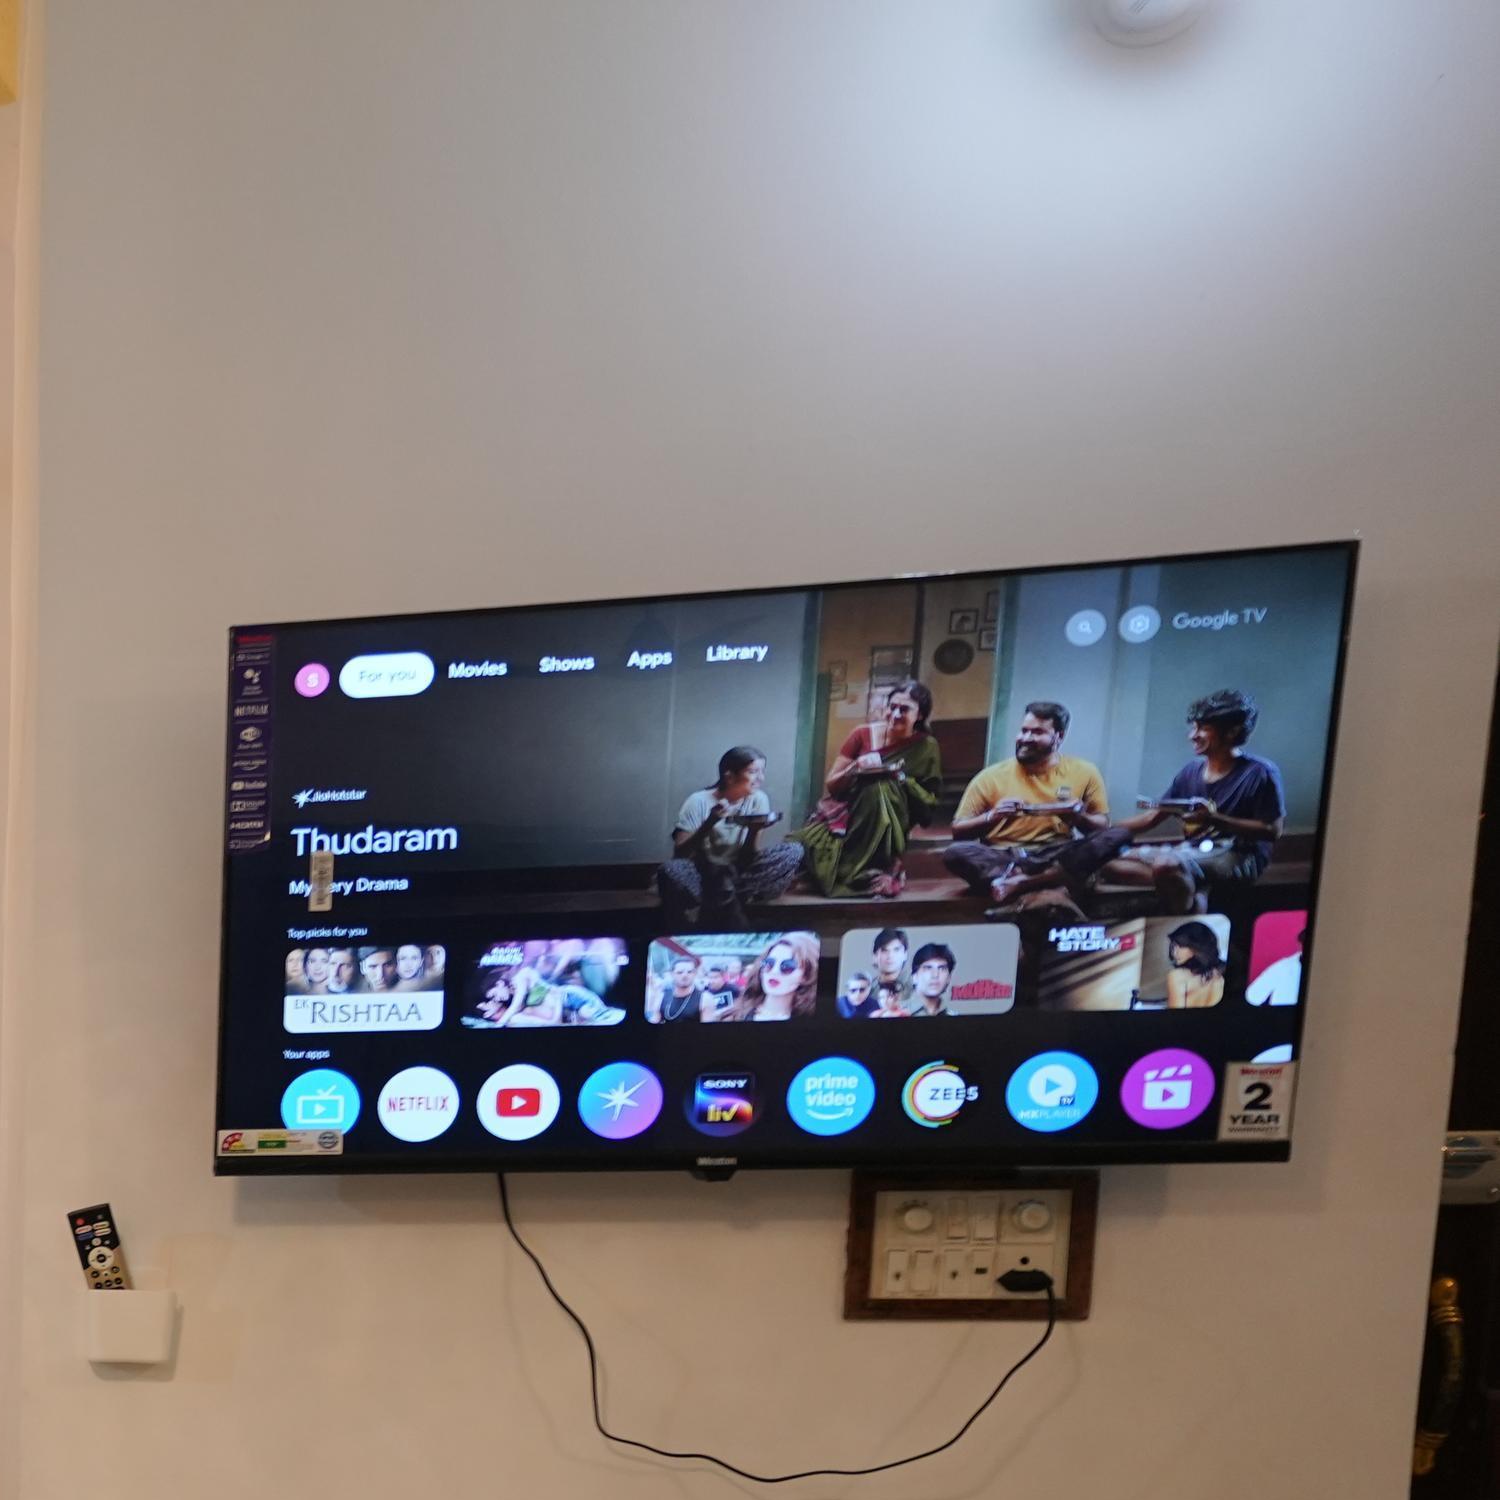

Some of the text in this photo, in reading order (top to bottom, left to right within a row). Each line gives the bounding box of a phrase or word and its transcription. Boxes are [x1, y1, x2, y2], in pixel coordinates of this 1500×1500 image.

[1172, 607, 1268, 630] Google TV
[626, 650, 673, 670] Apps
[706, 644, 769, 662] Library
[448, 661, 508, 679] Movies
[538, 656, 595, 673] Shows
[359, 669, 417, 683] For you
[289, 824, 458, 857] Thudaram
[288, 877, 409, 898] Myery Drama
[286, 927, 306, 941] Top
[332, 926, 348, 937] for
[348, 927, 368, 938] you
[1048, 926, 1105, 942] HATE
[1056, 938, 1120, 952] STORY
[311, 1001, 423, 1024] RISHTAA
[283, 1048, 330, 1061] Your apps
[703, 1079, 748, 1089] SONY
[804, 1073, 858, 1093] prime
[805, 1090, 857, 1107] video
[929, 1086, 979, 1101] ZEE5
[1244, 1082, 1272, 1110] 2
[387, 1096, 449, 1112] NETFLIX
[1230, 1113, 1280, 1125] YEAR
